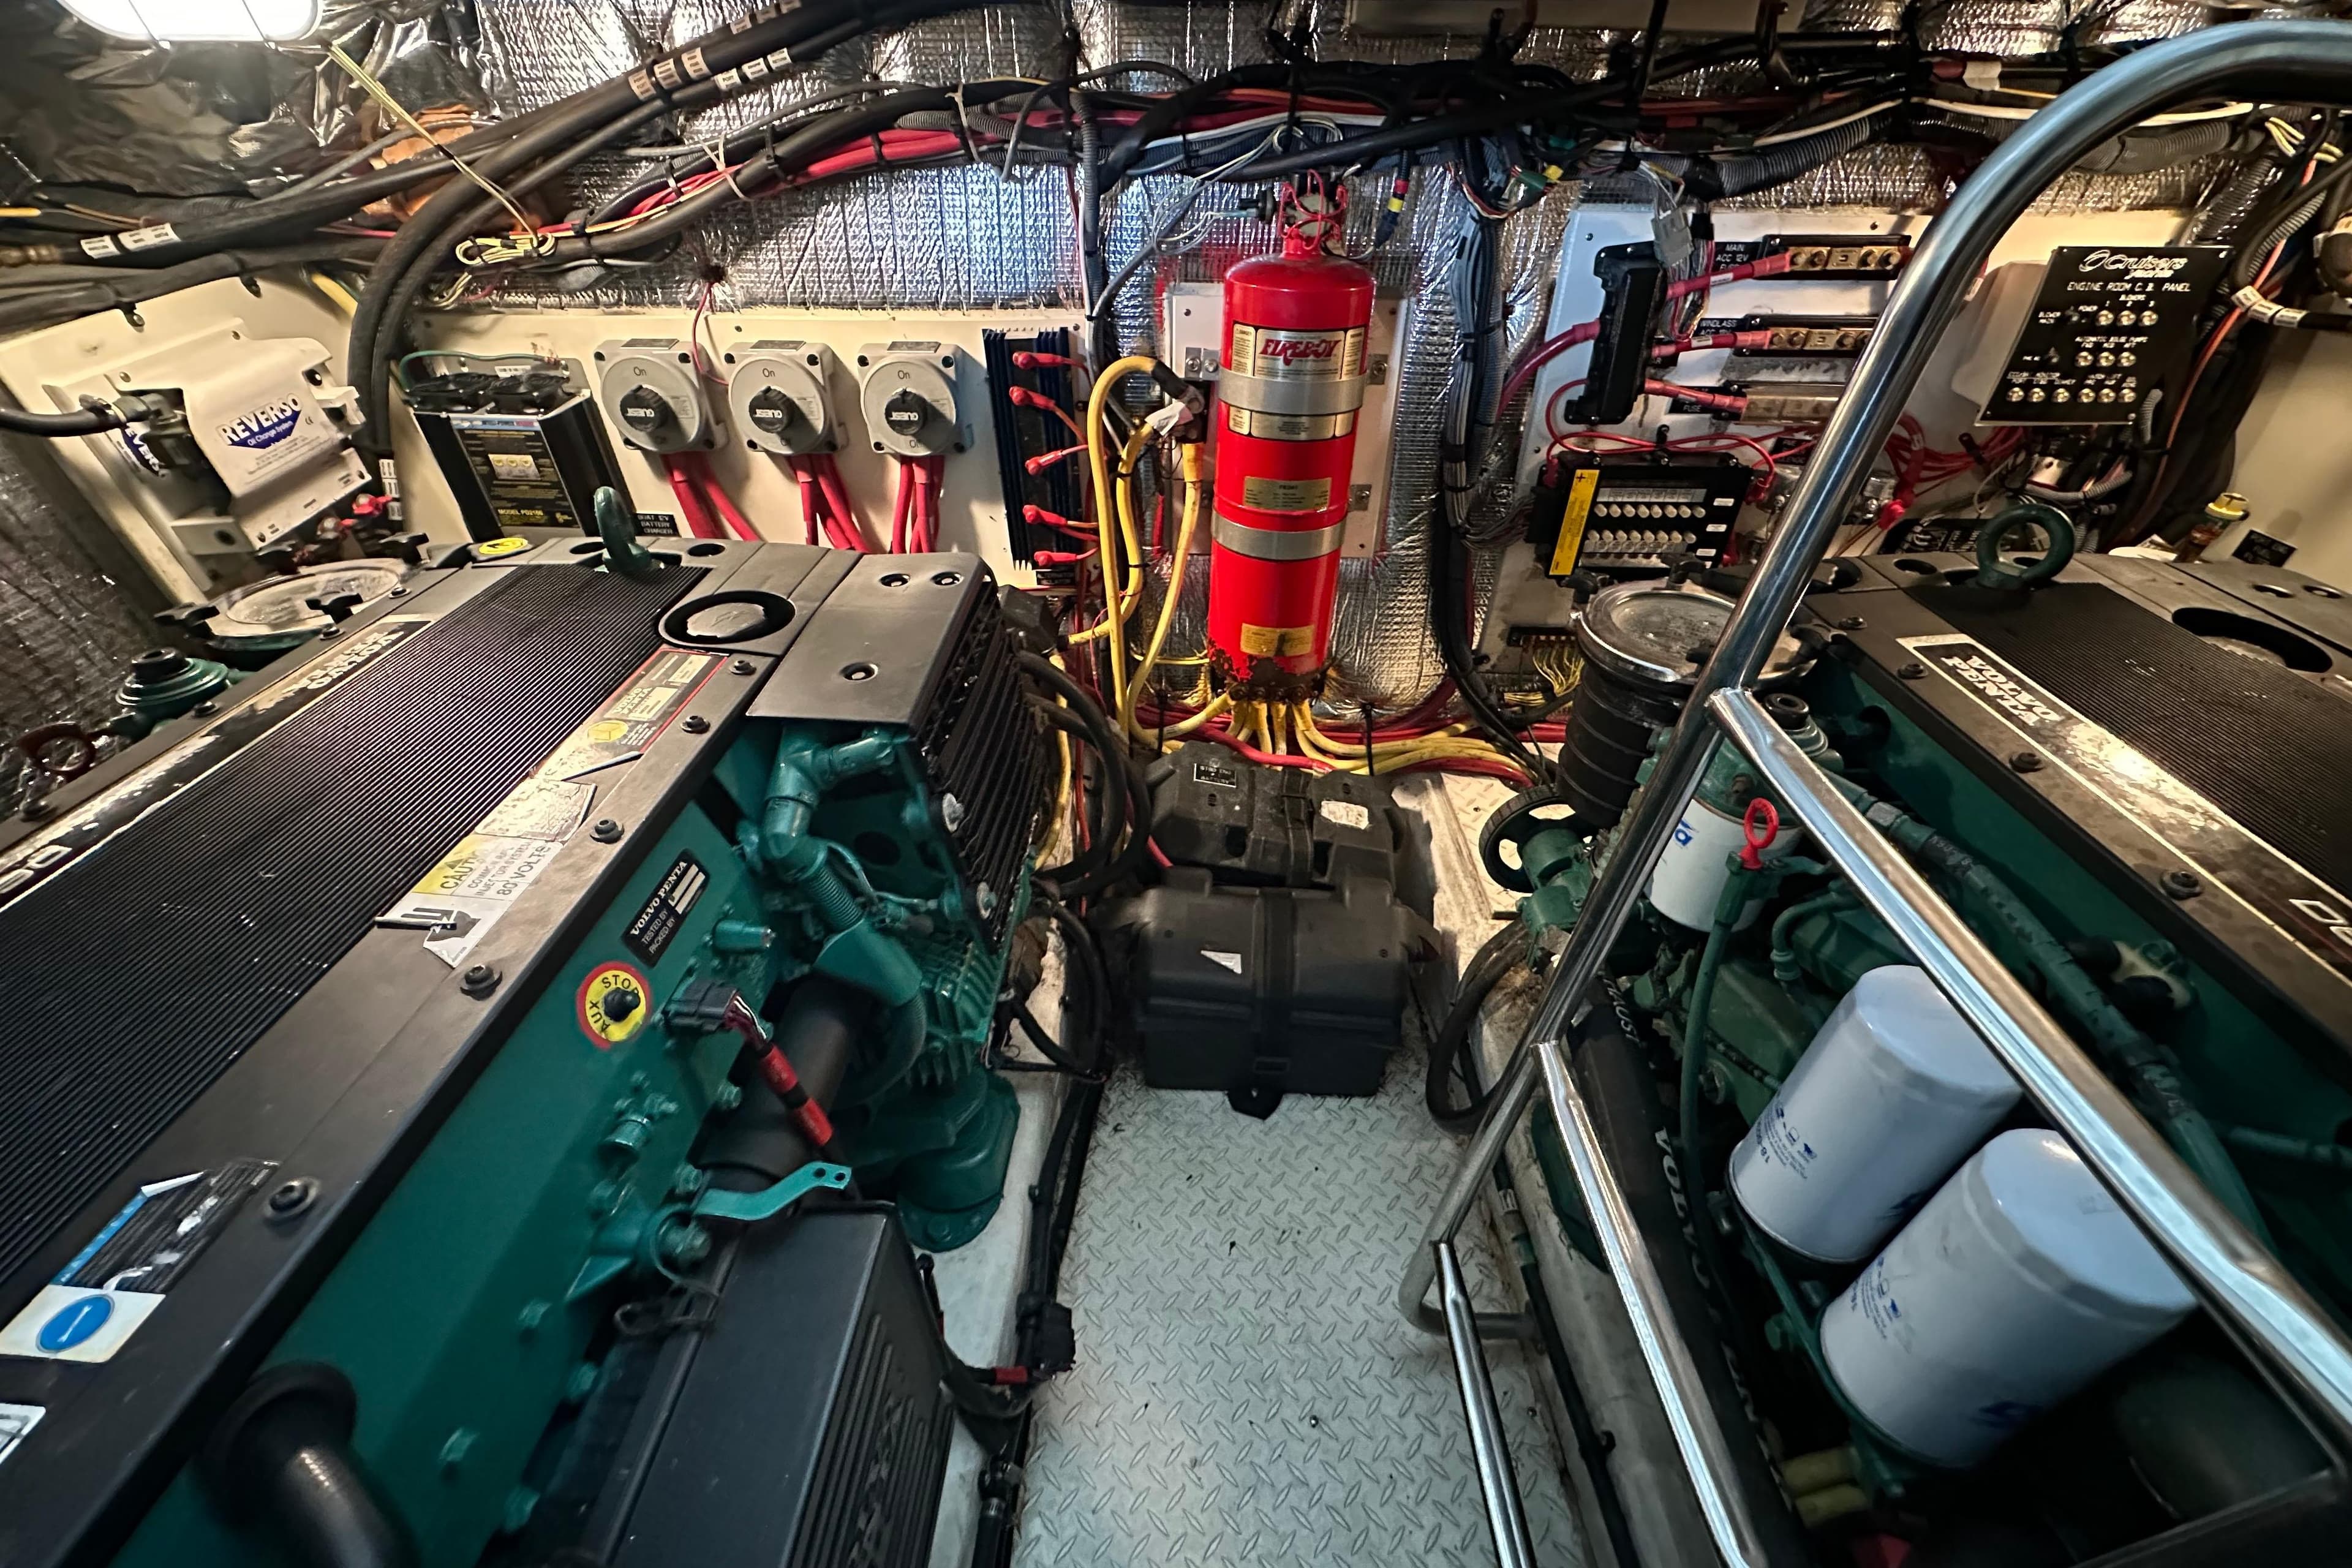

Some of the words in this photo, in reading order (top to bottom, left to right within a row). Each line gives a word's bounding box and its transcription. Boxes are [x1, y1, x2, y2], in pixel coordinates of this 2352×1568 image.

[1716, 254, 1733, 262] ACC
[2104, 254, 2188, 270] Cruisers
[2067, 282, 2105, 292] ENGINE
[2106, 282, 2132, 292] ROOM
[2162, 282, 2192, 292] PANEL
[1700, 319, 1737, 328] WINDLASS
[1259, 339, 1342, 366] FIREBOY
[633, 366, 647, 376] On
[761, 368, 776, 378] On
[897, 369, 911, 380] On
[217, 393, 301, 445] REVERSO
[1683, 404, 1702, 413] FUSE
[255, 429, 276, 442] Change
[276, 420, 294, 432] System
[307, 631, 404, 690] VOLVO
[1940, 656, 2040, 726] PENTA
[1966, 655, 2065, 722] VOLVO
[496, 881, 519, 895] 80
[630, 897, 661, 935] VOLVO
[657, 861, 688, 899] PENTA
[641, 918, 662, 944] TESTED
[649, 924, 670, 954] PACKED
[589, 1000, 611, 1033] AUX
